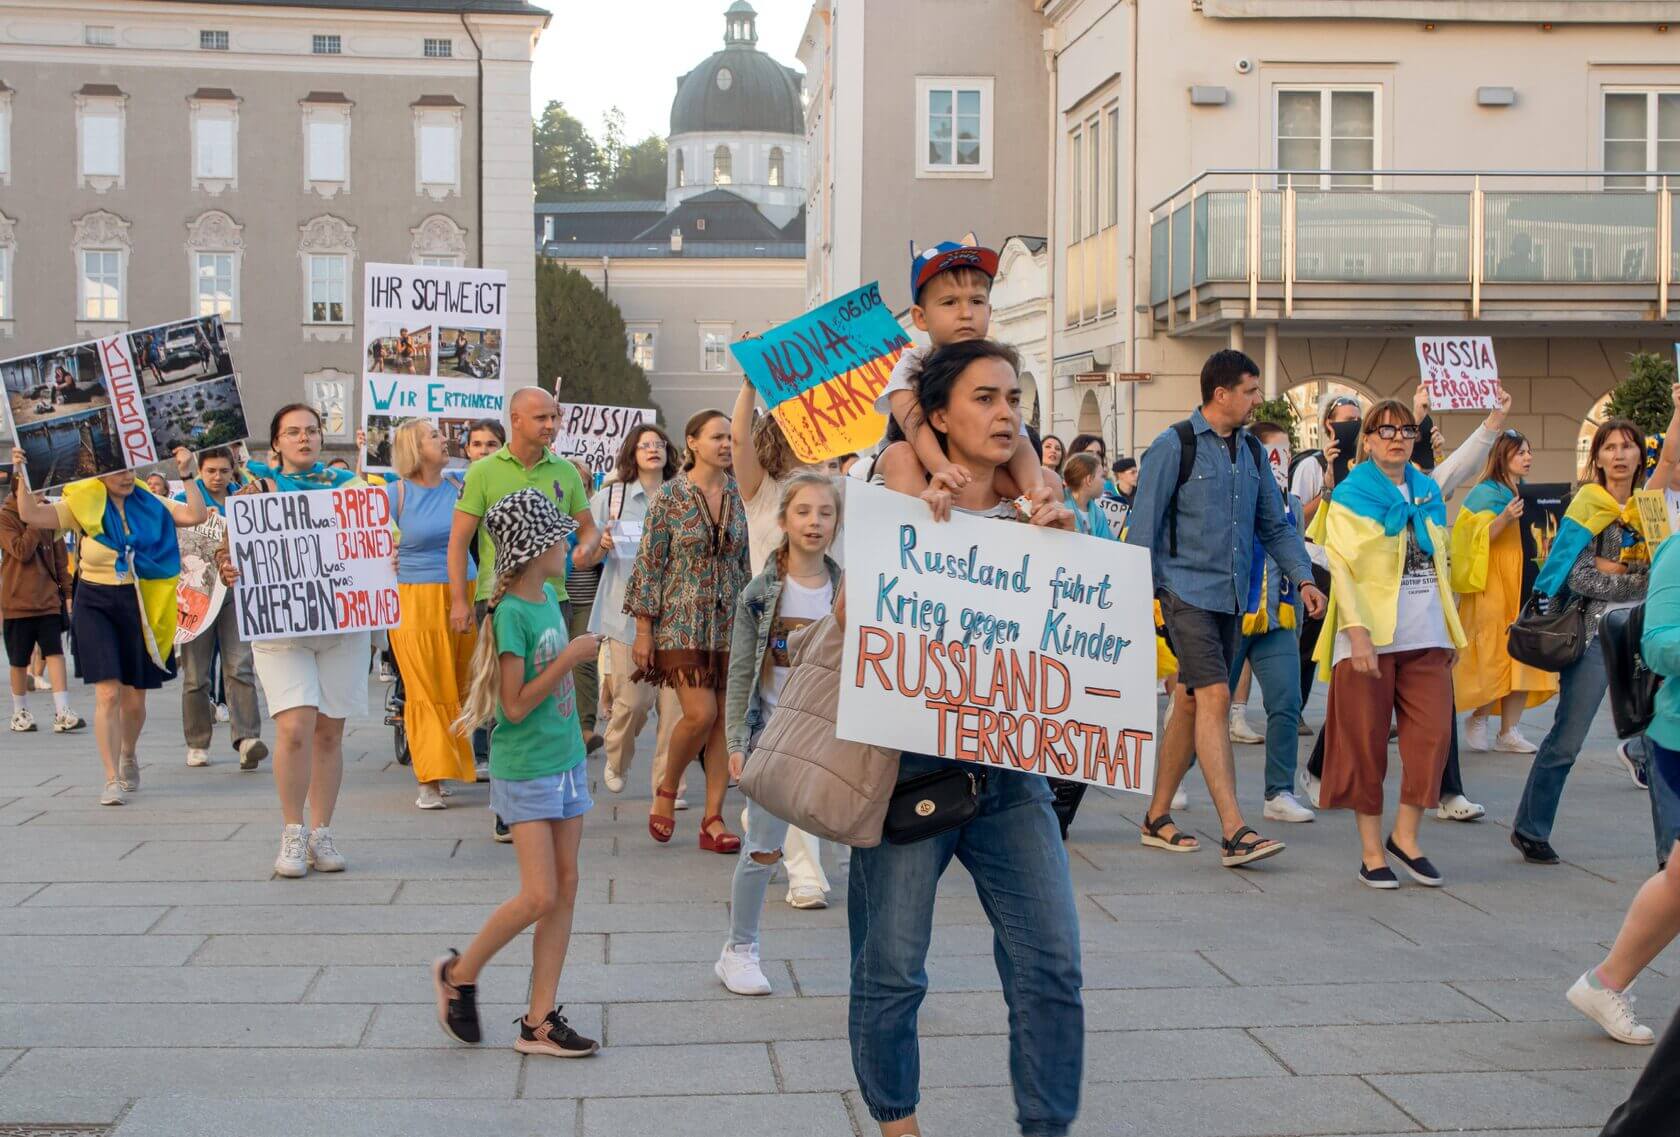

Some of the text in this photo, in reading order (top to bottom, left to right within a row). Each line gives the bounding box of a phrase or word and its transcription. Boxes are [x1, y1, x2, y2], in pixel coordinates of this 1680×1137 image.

[371, 276, 402, 309] IHR
[838, 285, 883, 323] 06.06
[762, 319, 858, 392] NOVA
[1421, 340, 1494, 370] RUSSIA
[101, 337, 154, 466] KHERSON
[798, 334, 913, 443] KAKHO
[1451, 397, 1487, 409] STATE
[575, 438, 606, 456] IS A
[234, 494, 314, 535] BUCHA
[312, 516, 336, 529] was
[332, 487, 391, 530] RAPED
[1100, 500, 1128, 512] STOP
[324, 562, 346, 574] was
[336, 529, 394, 560] BURNED
[899, 523, 1114, 610] Russland führt
[239, 575, 401, 637] KHERSON was DROWNED
[876, 572, 1132, 665] Krieg gegen Kinder
[855, 625, 1072, 716] RUSSLAND
[925, 699, 1153, 790] TERRORSTAAT
